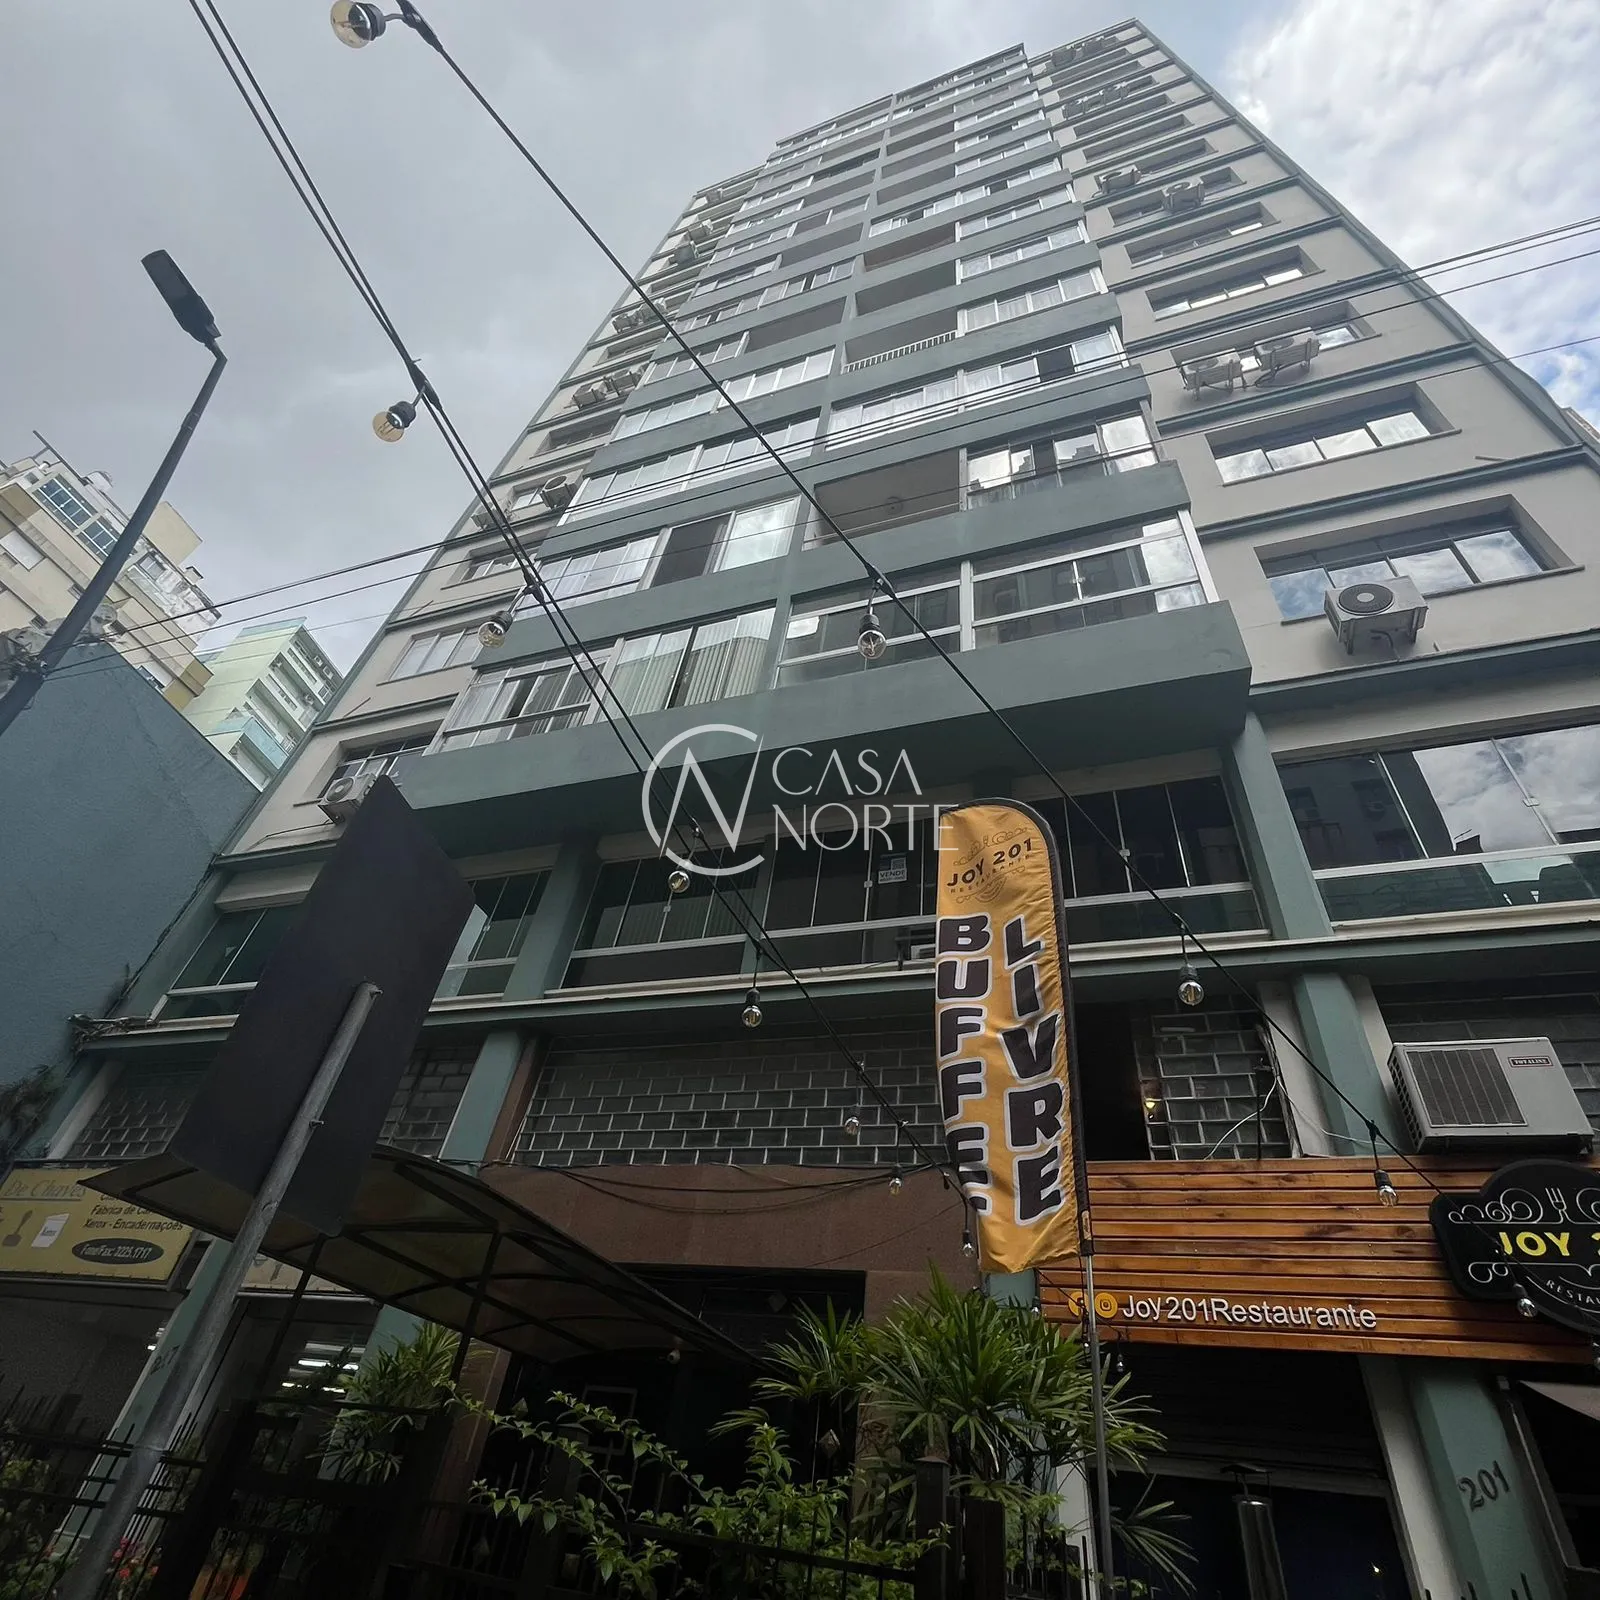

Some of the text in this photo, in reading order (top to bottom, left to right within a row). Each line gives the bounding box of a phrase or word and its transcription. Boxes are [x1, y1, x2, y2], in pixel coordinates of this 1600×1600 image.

[947, 838, 1032, 886] JOY 201
[937, 914, 992, 1213] BUFFE
[1001, 916, 1064, 1222] LIVRE
[1457, 1460, 1509, 1512] 201
